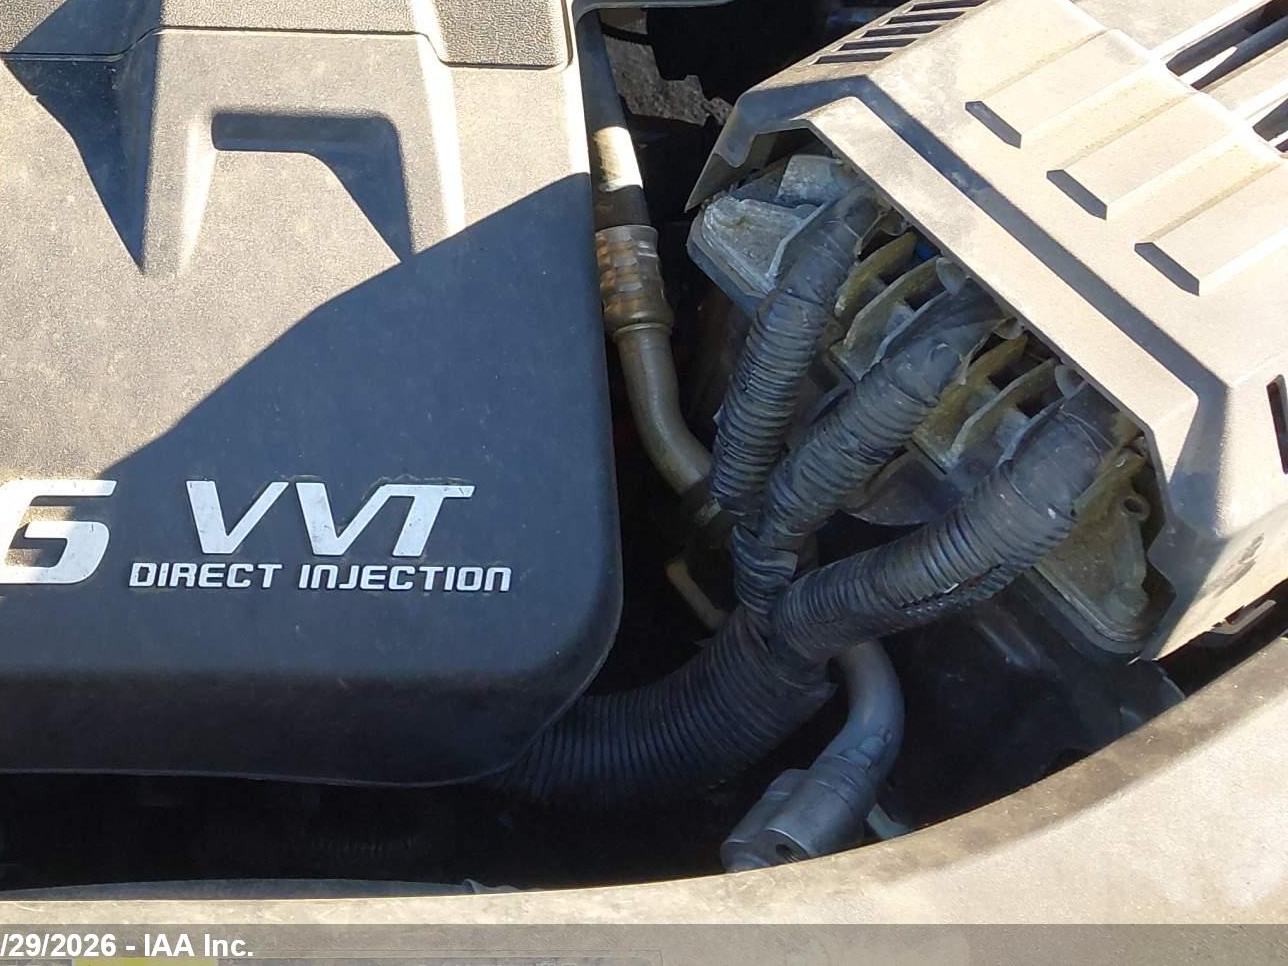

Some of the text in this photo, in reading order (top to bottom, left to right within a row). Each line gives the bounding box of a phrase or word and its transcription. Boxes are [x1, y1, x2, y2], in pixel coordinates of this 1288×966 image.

[186, 480, 475, 557] VVT
[129, 562, 512, 592] DIRECT INJECTION
